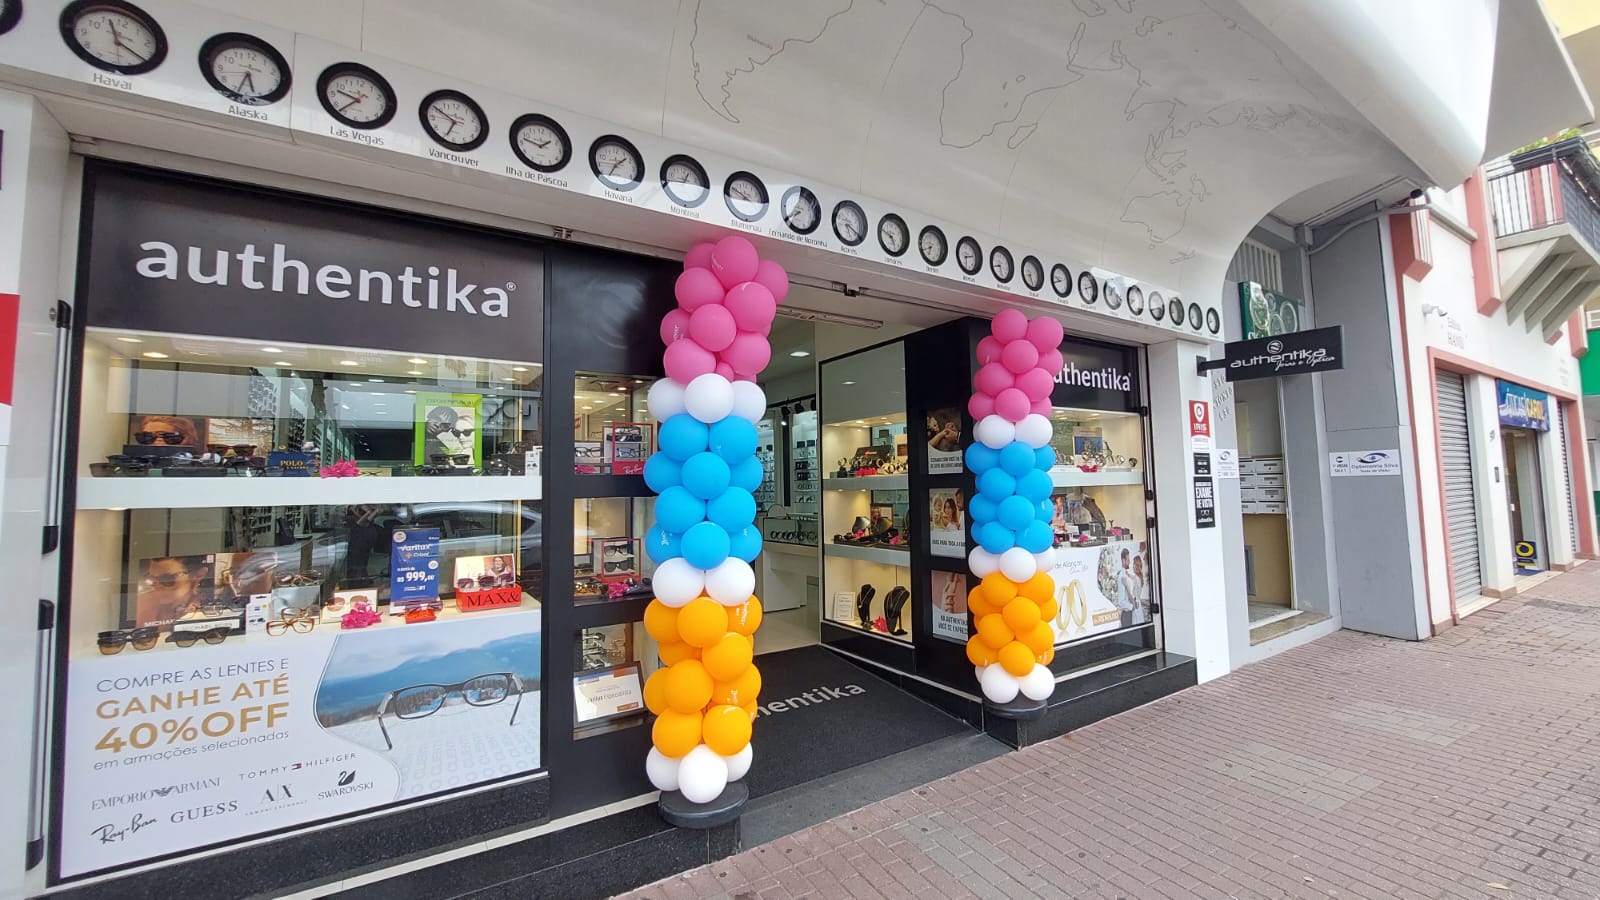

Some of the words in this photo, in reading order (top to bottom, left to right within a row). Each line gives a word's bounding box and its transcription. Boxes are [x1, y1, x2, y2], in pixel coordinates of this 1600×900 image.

[228, 104, 268, 121] Alaska
[330, 125, 348, 138] Las
[351, 130, 384, 146] Vegas
[429, 148, 480, 167] Vancouver
[525, 171, 535, 180] de
[1230, 348, 1326, 368] authentika
[1053, 361, 1131, 392] uthentika
[280, 460, 304, 468] POLO
[96, 670, 184, 693] COMPRE
[190, 667, 213, 681] AS
[218, 659, 274, 677] LENTES
[280, 658, 289, 670] E
[95, 685, 221, 720] GANHE
[231, 672, 289, 701] ATÉ
[93, 759, 119, 771] em
[123, 746, 198, 768] armações
[201, 730, 289, 753] selecionadas
[239, 766, 288, 781] TOMMY
[305, 752, 357, 768] HILFIGER
[91, 789, 155, 812] EMPORIO
[173, 775, 222, 796] ARMANI
[317, 781, 374, 800] SWAROVSKI
[170, 800, 238, 825] GUESS
[90, 812, 159, 845] Ray-Ban
